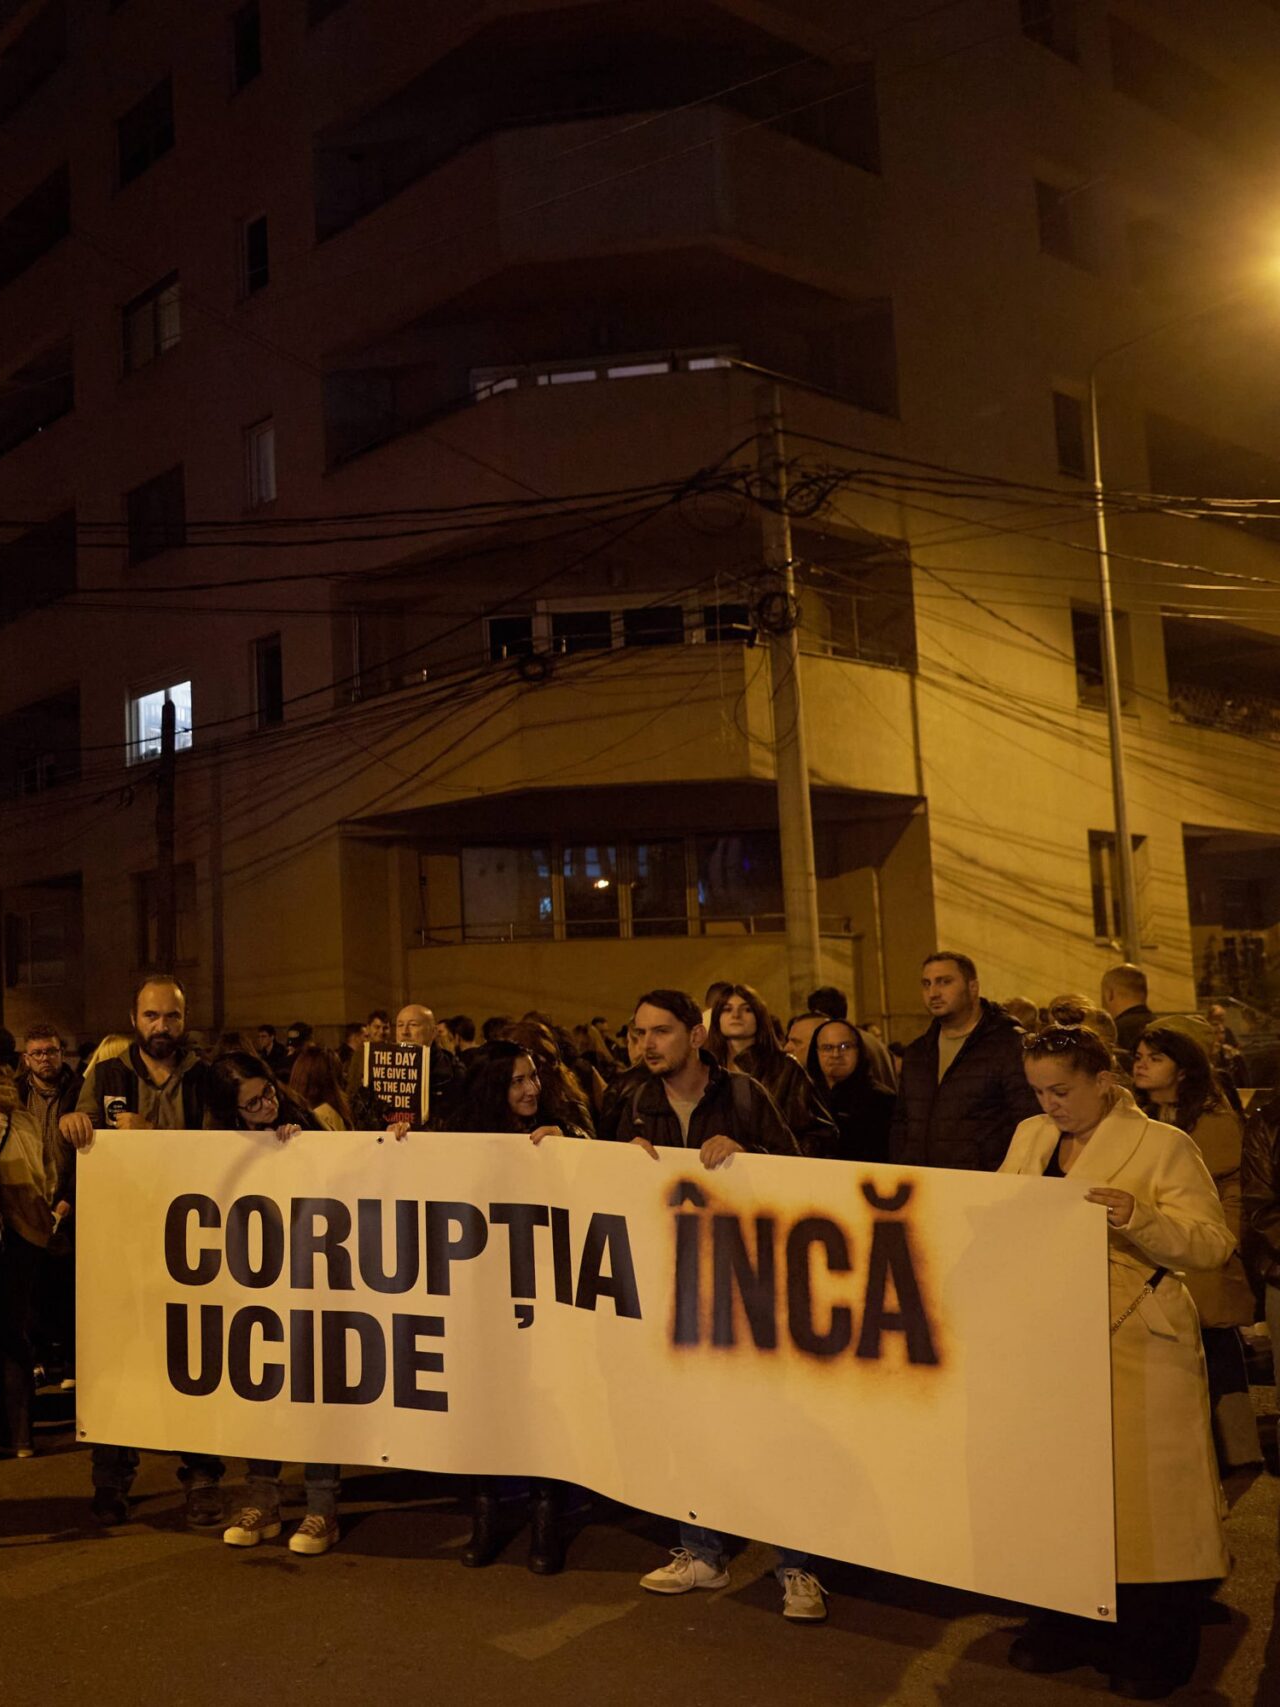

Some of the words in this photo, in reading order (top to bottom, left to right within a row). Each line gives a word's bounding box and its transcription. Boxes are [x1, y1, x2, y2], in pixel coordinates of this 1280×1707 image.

[373, 1051, 392, 1065] THE
[395, 1052, 417, 1066] DAY
[372, 1066, 385, 1078] WE
[386, 1067, 406, 1080] GIVE
[408, 1068, 418, 1080] IN
[373, 1081, 381, 1092] IS
[383, 1081, 398, 1093] THE
[400, 1082, 417, 1094] DAY
[395, 1095, 410, 1108] DIE
[165, 1193, 642, 1329] CORUPȚIA
[667, 1180, 939, 1366] ÎNCĂ
[166, 1302, 448, 1412] UCIDE
